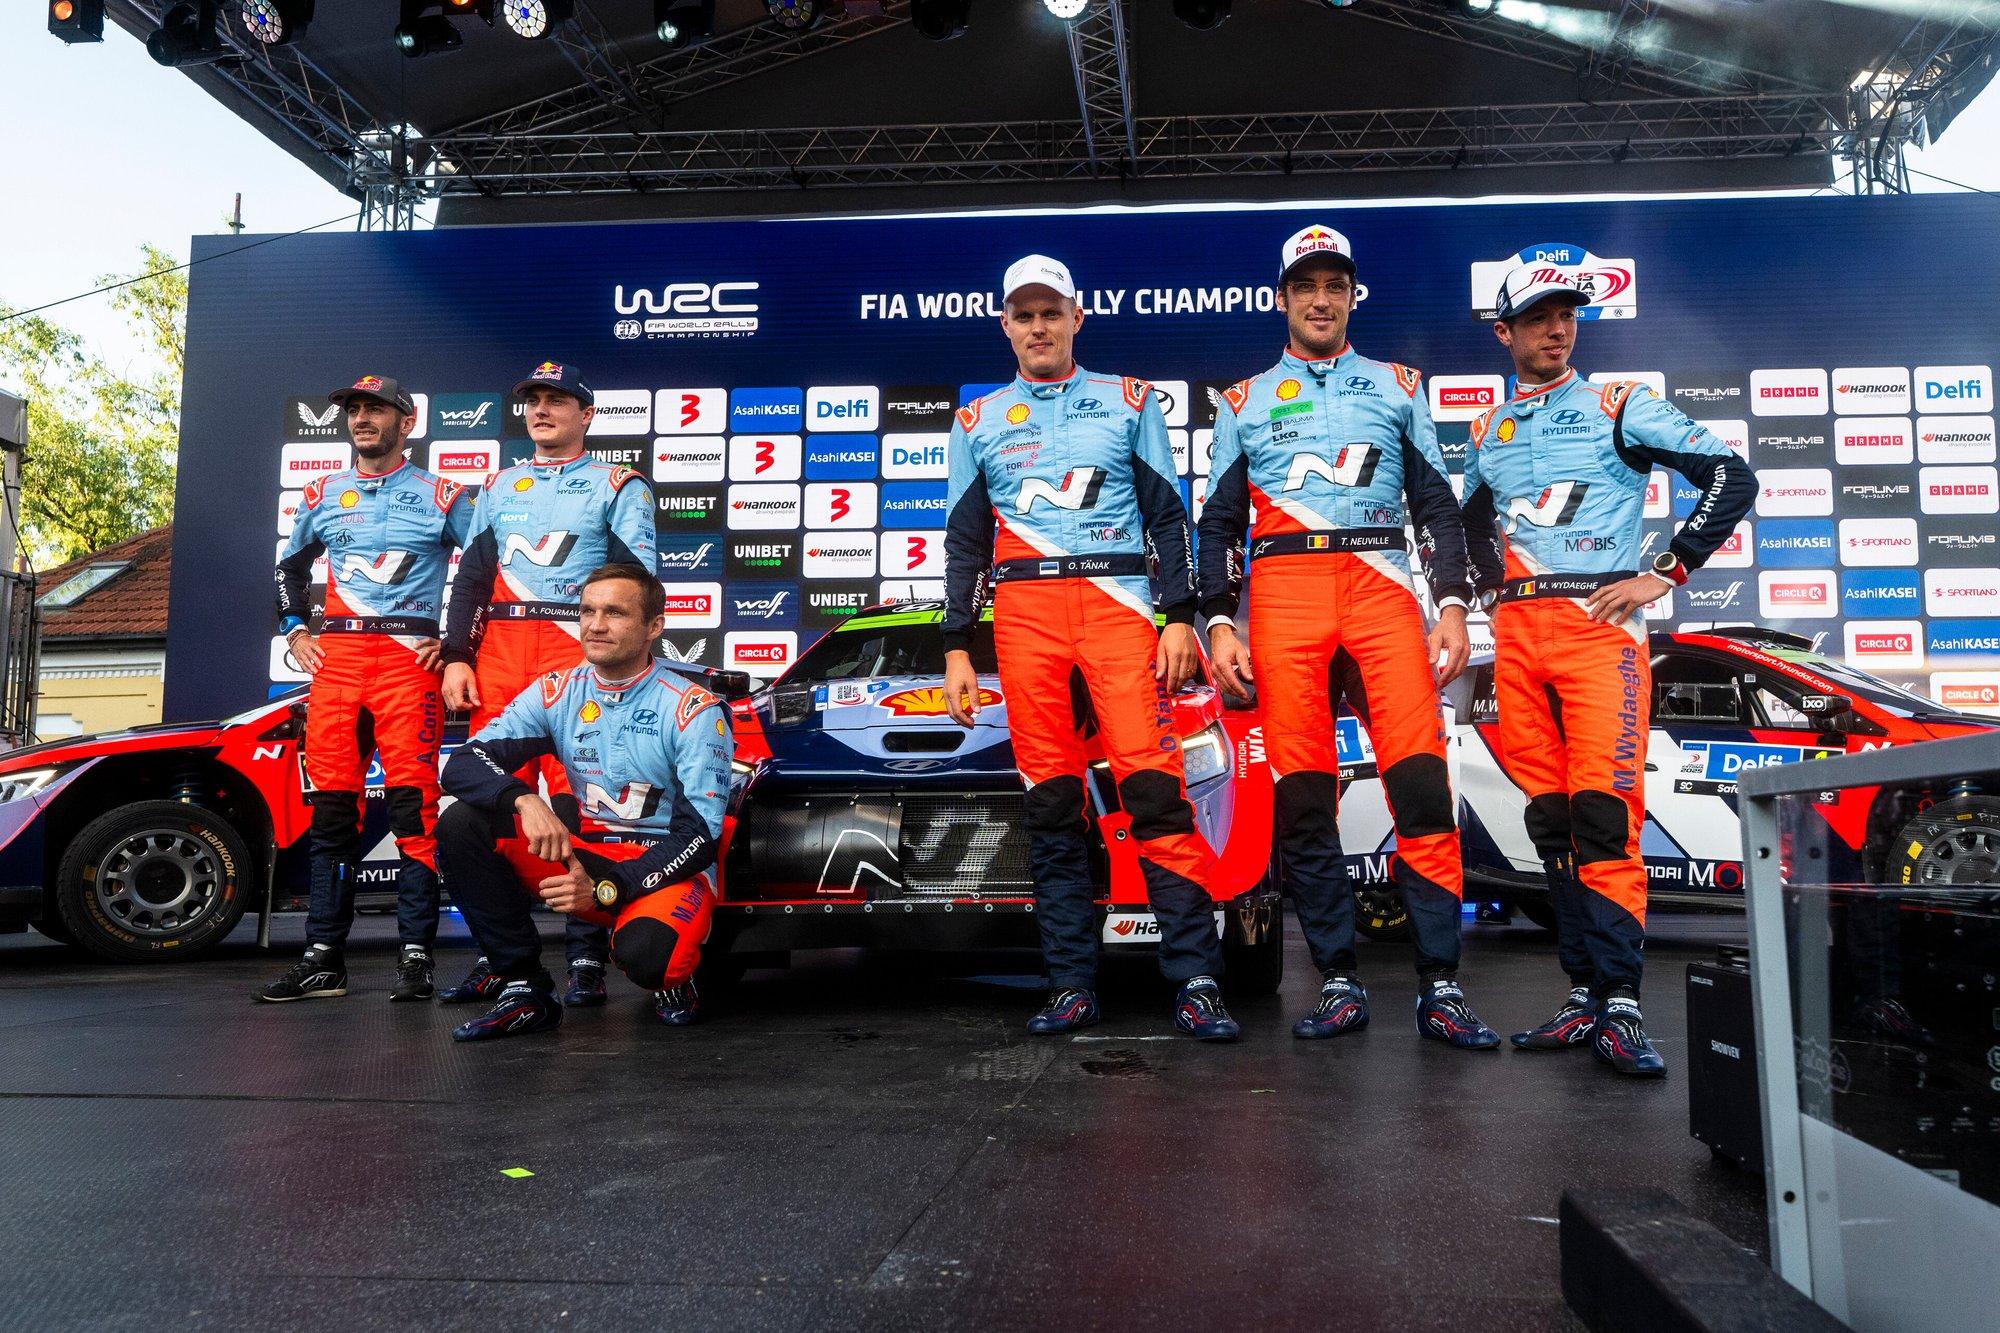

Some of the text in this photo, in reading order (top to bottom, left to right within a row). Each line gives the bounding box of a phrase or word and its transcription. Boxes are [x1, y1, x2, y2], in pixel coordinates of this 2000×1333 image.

[1296, 241, 1338, 256] Red Bull
[1536, 250, 1569, 262] Delfi
[614, 282, 759, 315] WRC
[861, 294, 908, 319] FIA
[917, 292, 1003, 317] WORL
[1077, 290, 1126, 315] LLY
[647, 331, 755, 339] CHAMPIONSHIP
[1339, 390, 1383, 398] HYUNDAI
[1675, 388, 1740, 397] FORUM8
[1760, 387, 1818, 398] CRAMO
[1925, 380, 1981, 399] Delfi
[1444, 391, 1489, 402] CIRCLE K
[733, 404, 800, 415] AsahiKASEI
[817, 399, 869, 418] Delfi
[887, 401, 949, 410] FORUM8
[1272, 431, 1299, 442] LKQ
[1542, 426, 1591, 436] HYUNDAI
[1758, 436, 1824, 445] FORUM8
[1844, 436, 1903, 447] CRAMO
[808, 452, 875, 462] AsahiKASEI
[892, 447, 945, 465] Delfi
[442, 458, 472, 466] CIRCLE
[1006, 460, 1034, 470] FORUS
[1777, 488, 1826, 497] SPORTLAND
[1843, 485, 1909, 495] FORUM8
[1929, 485, 1988, 496] CRAMO
[660, 497, 716, 510] UNIBET
[884, 498, 947, 509] AsahiKASE
[501, 513, 528, 522] Nord
[1363, 509, 1400, 525] MOBIS
[1091, 528, 1131, 541] MOBIS
[1553, 530, 1593, 538] HYUNDAI
[1928, 535, 1995, 544] FORUM8
[1341, 536, 1389, 546] T. NEUVILLE
[1565, 537, 1617, 552] MOBIS
[1760, 537, 1831, 548] AsahiKASEI
[1861, 538, 1911, 546] SPORTLAND
[734, 545, 791, 557] UNIBET
[1069, 560, 1110, 570] O. TÄNAK
[1550, 582, 1598, 590] WYDAEGHE
[1774, 587, 1821, 599] CIRCLE K
[1845, 587, 1917, 598] AsahiKASEI
[1947, 588, 1997, 596] SPORTLAND
[664, 600, 694, 608] CIRCLE
[810, 594, 868, 606] UNIBET
[393, 601, 433, 612] MOBIS
[540, 607, 580, 616] FOURMAU
[1859, 637, 1907, 649] CIRCLE K
[1931, 638, 2000, 649] AsahiKASE
[738, 649, 769, 658] CIRCLE
[1726, 643, 1834, 693] motorsport.hyundai.com
[1946, 688, 1993, 701] CIRCLE K
[1238, 741, 1247, 778] HYUNDAI
[1680, 781, 1693, 790] SC
[1820, 792, 1834, 801] SC
[1648, 866, 1682, 879] NDAI
